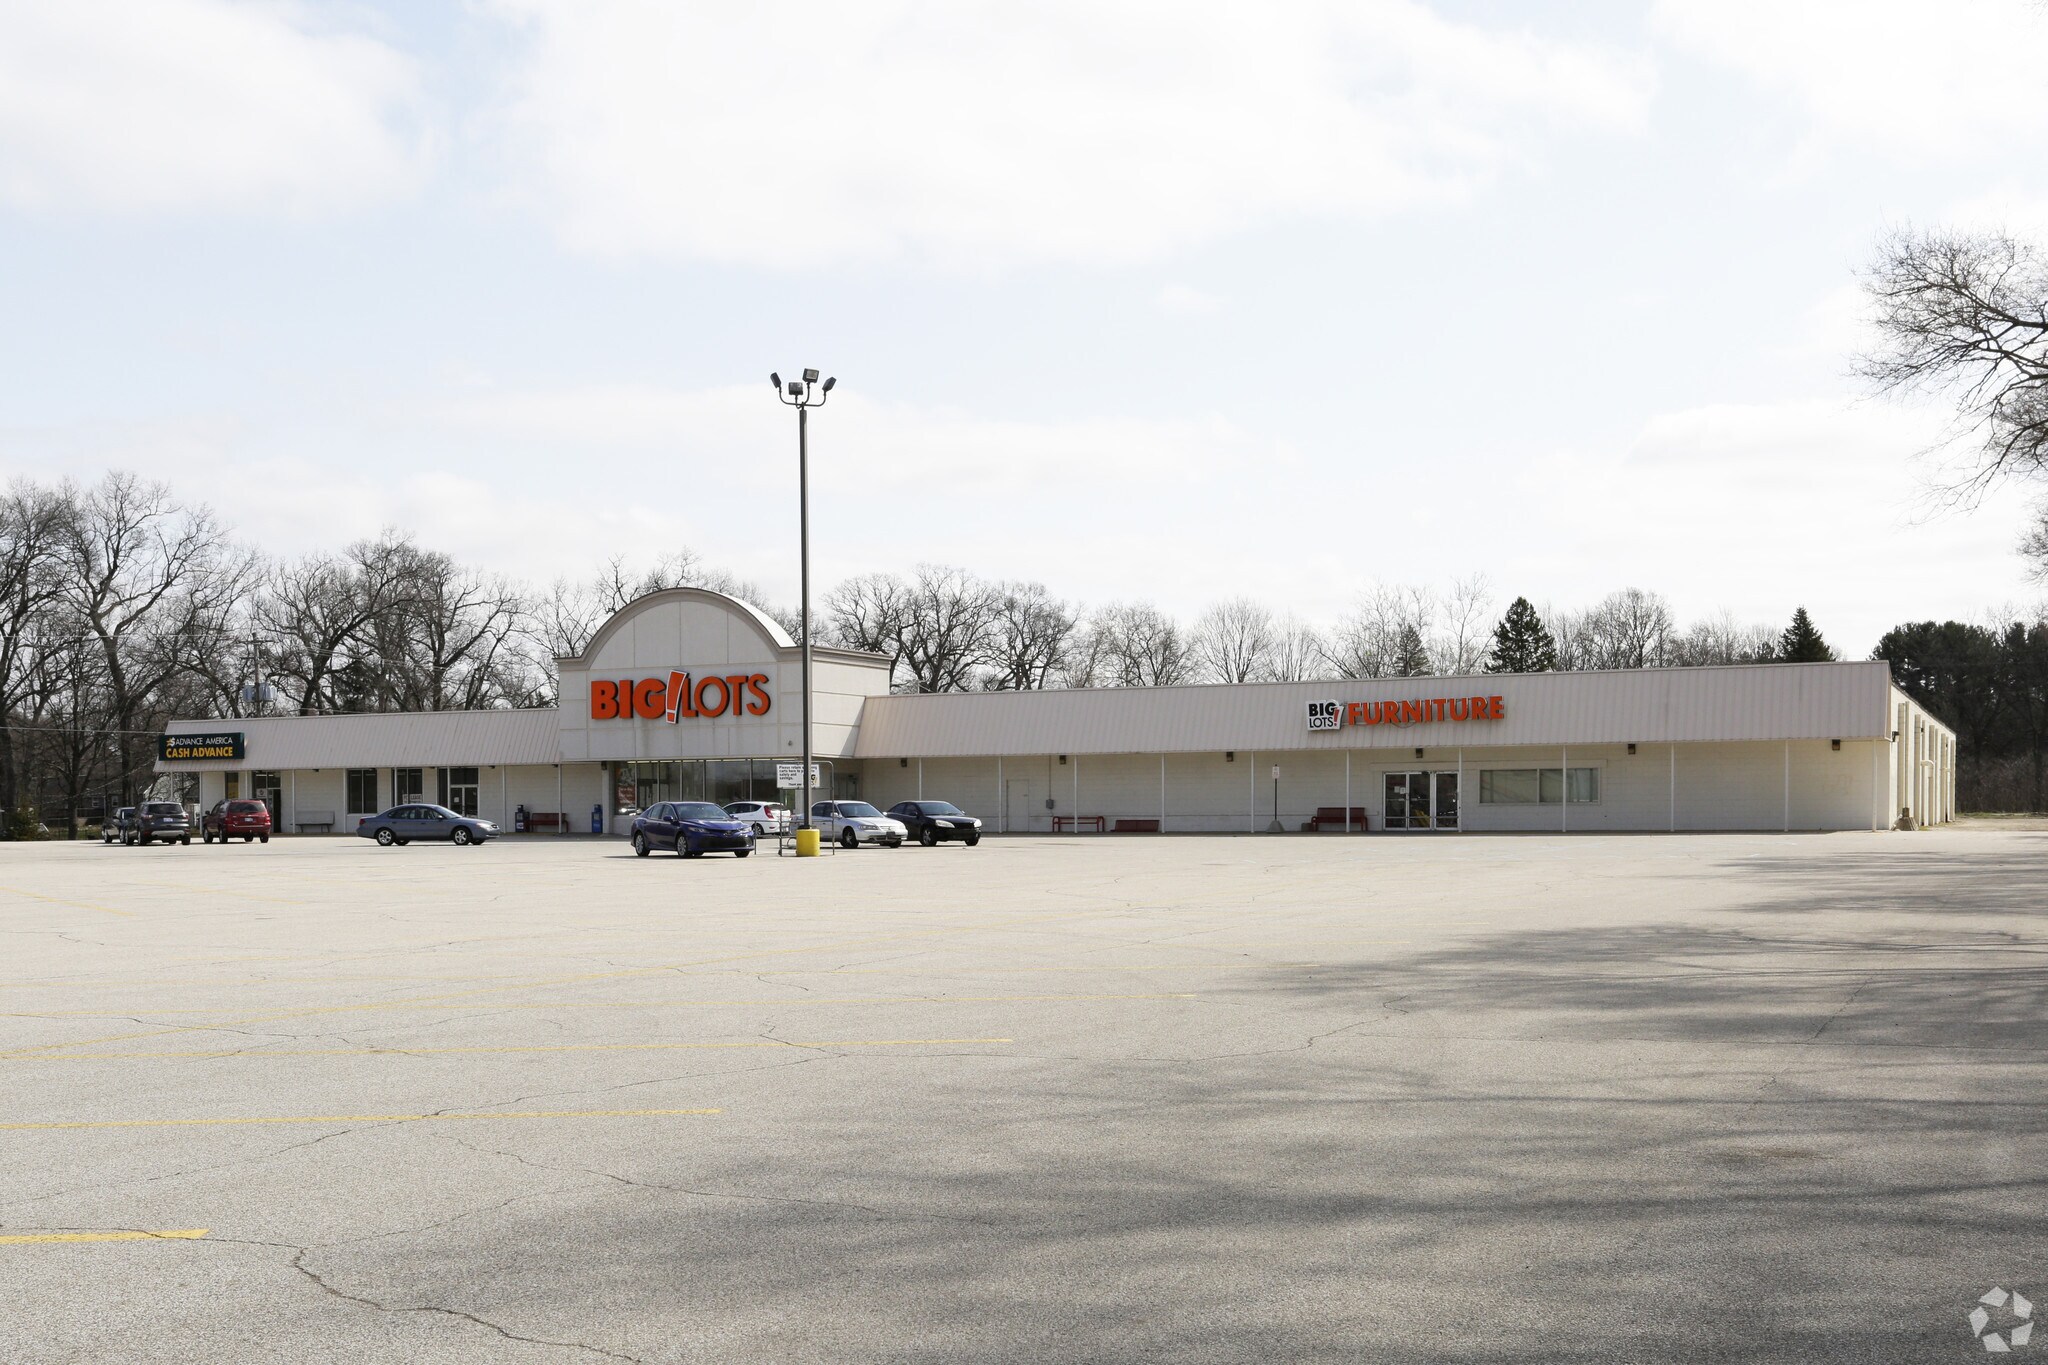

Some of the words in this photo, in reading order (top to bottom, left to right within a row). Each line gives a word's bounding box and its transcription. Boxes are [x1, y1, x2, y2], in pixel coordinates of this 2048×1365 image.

[1308, 702, 1336, 716] BIG
[1348, 695, 1505, 726] FURNITURE
[176, 738, 203, 746] ADVANCE
[205, 737, 233, 745] AMERICA
[166, 748, 190, 758] CASH
[192, 746, 233, 757] ADVANCE
